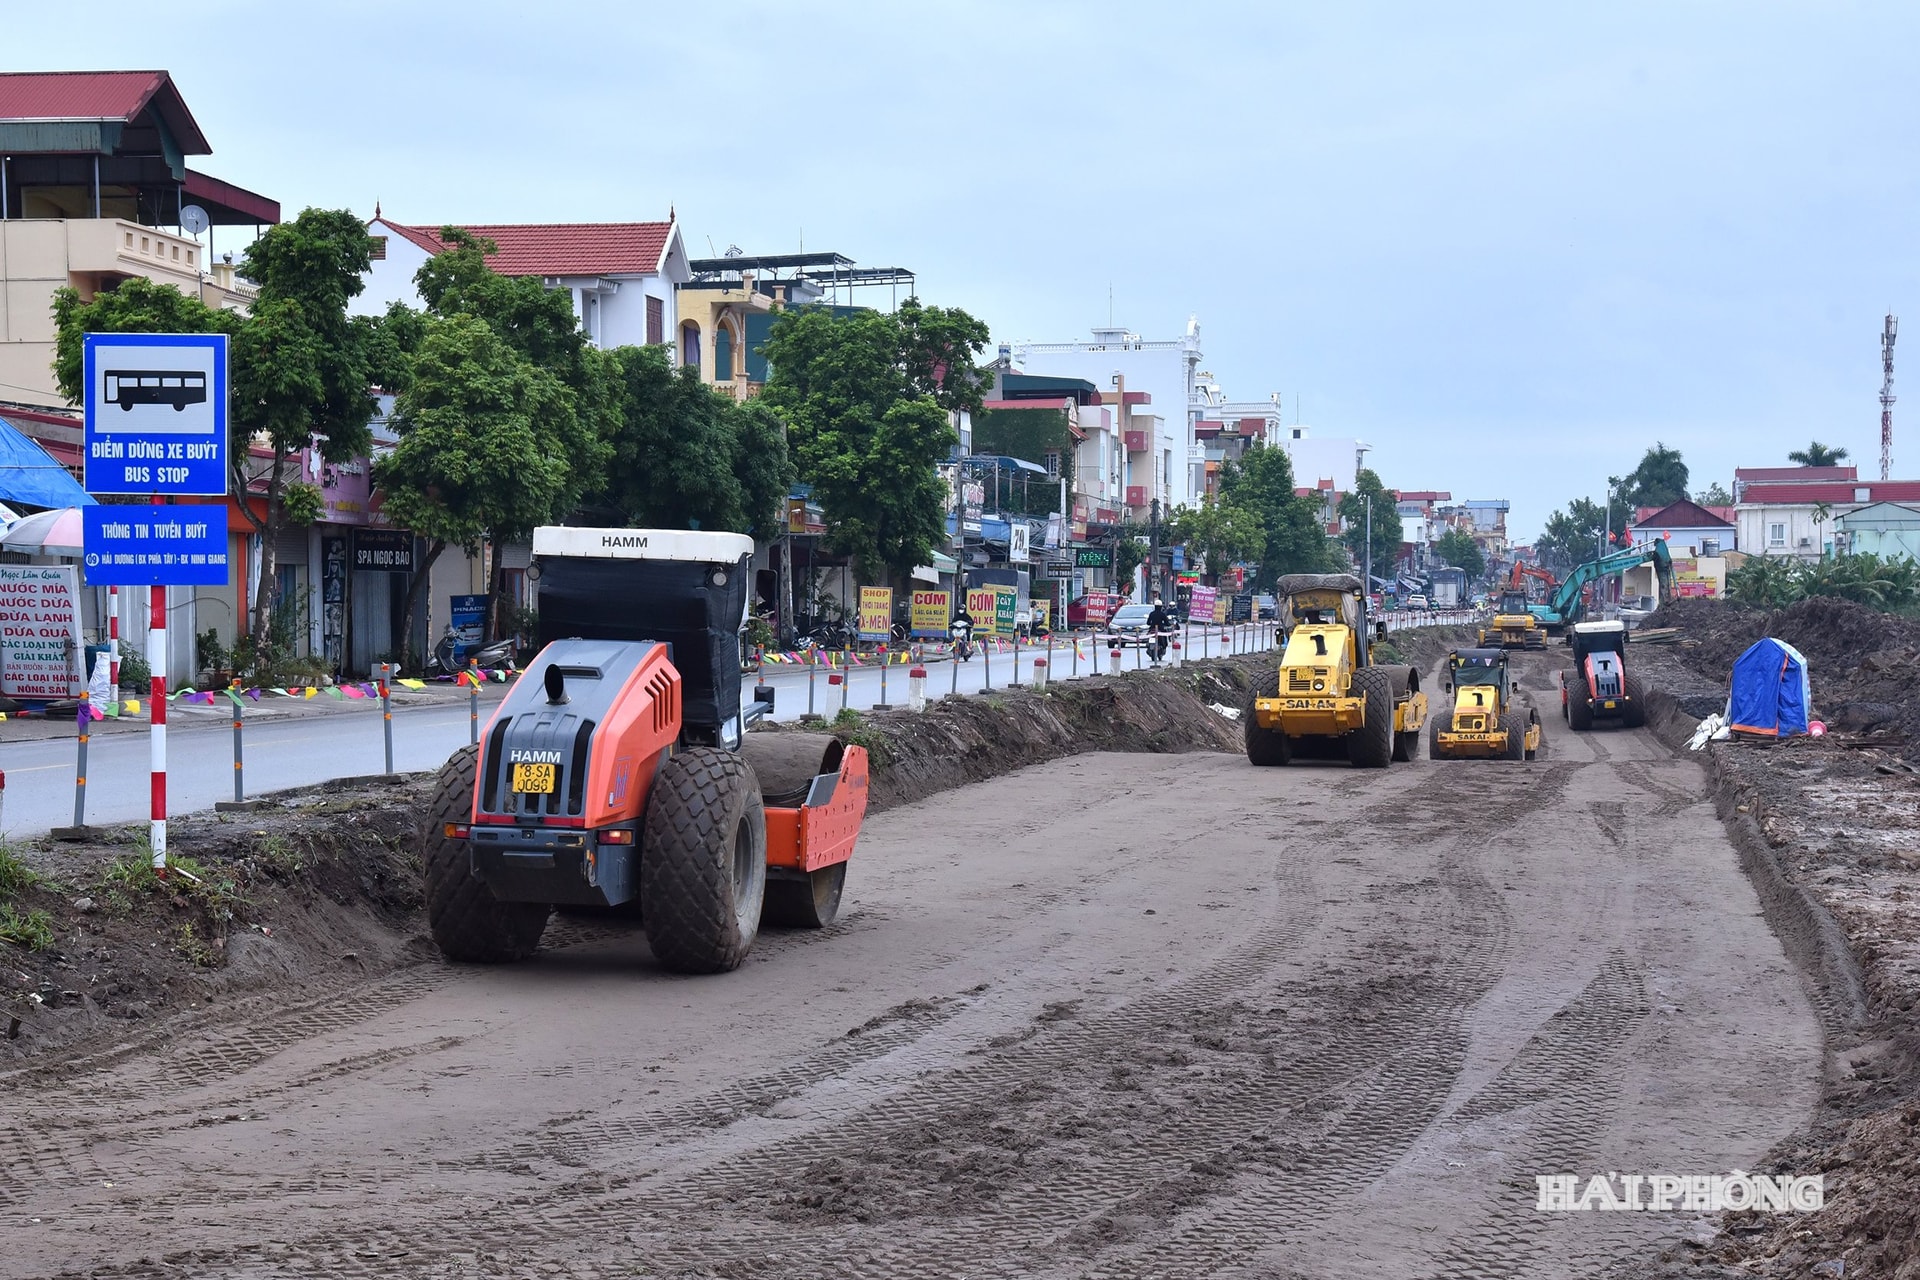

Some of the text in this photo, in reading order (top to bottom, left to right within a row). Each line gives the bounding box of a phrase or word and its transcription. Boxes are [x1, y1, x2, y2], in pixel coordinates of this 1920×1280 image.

[92, 435, 218, 460] ĐIỂM DỪNG XE BUÝT
[125, 466, 190, 483] BUS STOP
[102, 520, 207, 538] THÔNG TIN TUYẾN BUÝT
[602, 536, 648, 548] HAMM
[358, 550, 372, 564] SPA
[374, 550, 394, 568] NGỌC
[1, 569, 19, 581] Ngọc
[0, 582, 68, 594] NƯỚC MÍA
[0, 596, 72, 608] NƯỚC DỪA
[914, 592, 946, 605] CƠM
[970, 592, 994, 611] CƠM
[34, 613, 72, 624] LẠNH
[861, 615, 887, 629] X-MEN
[984, 616, 994, 624] XE
[4, 625, 70, 638] DỪA QUẢ
[1, 639, 20, 648] CÁC
[23, 642, 46, 650] LOẠI
[1310, 634, 1328, 656] 1
[4, 672, 24, 681] CÁC
[28, 673, 49, 683] LOẠI
[17, 685, 45, 694] NÔNG
[511, 750, 561, 763] HAMM
